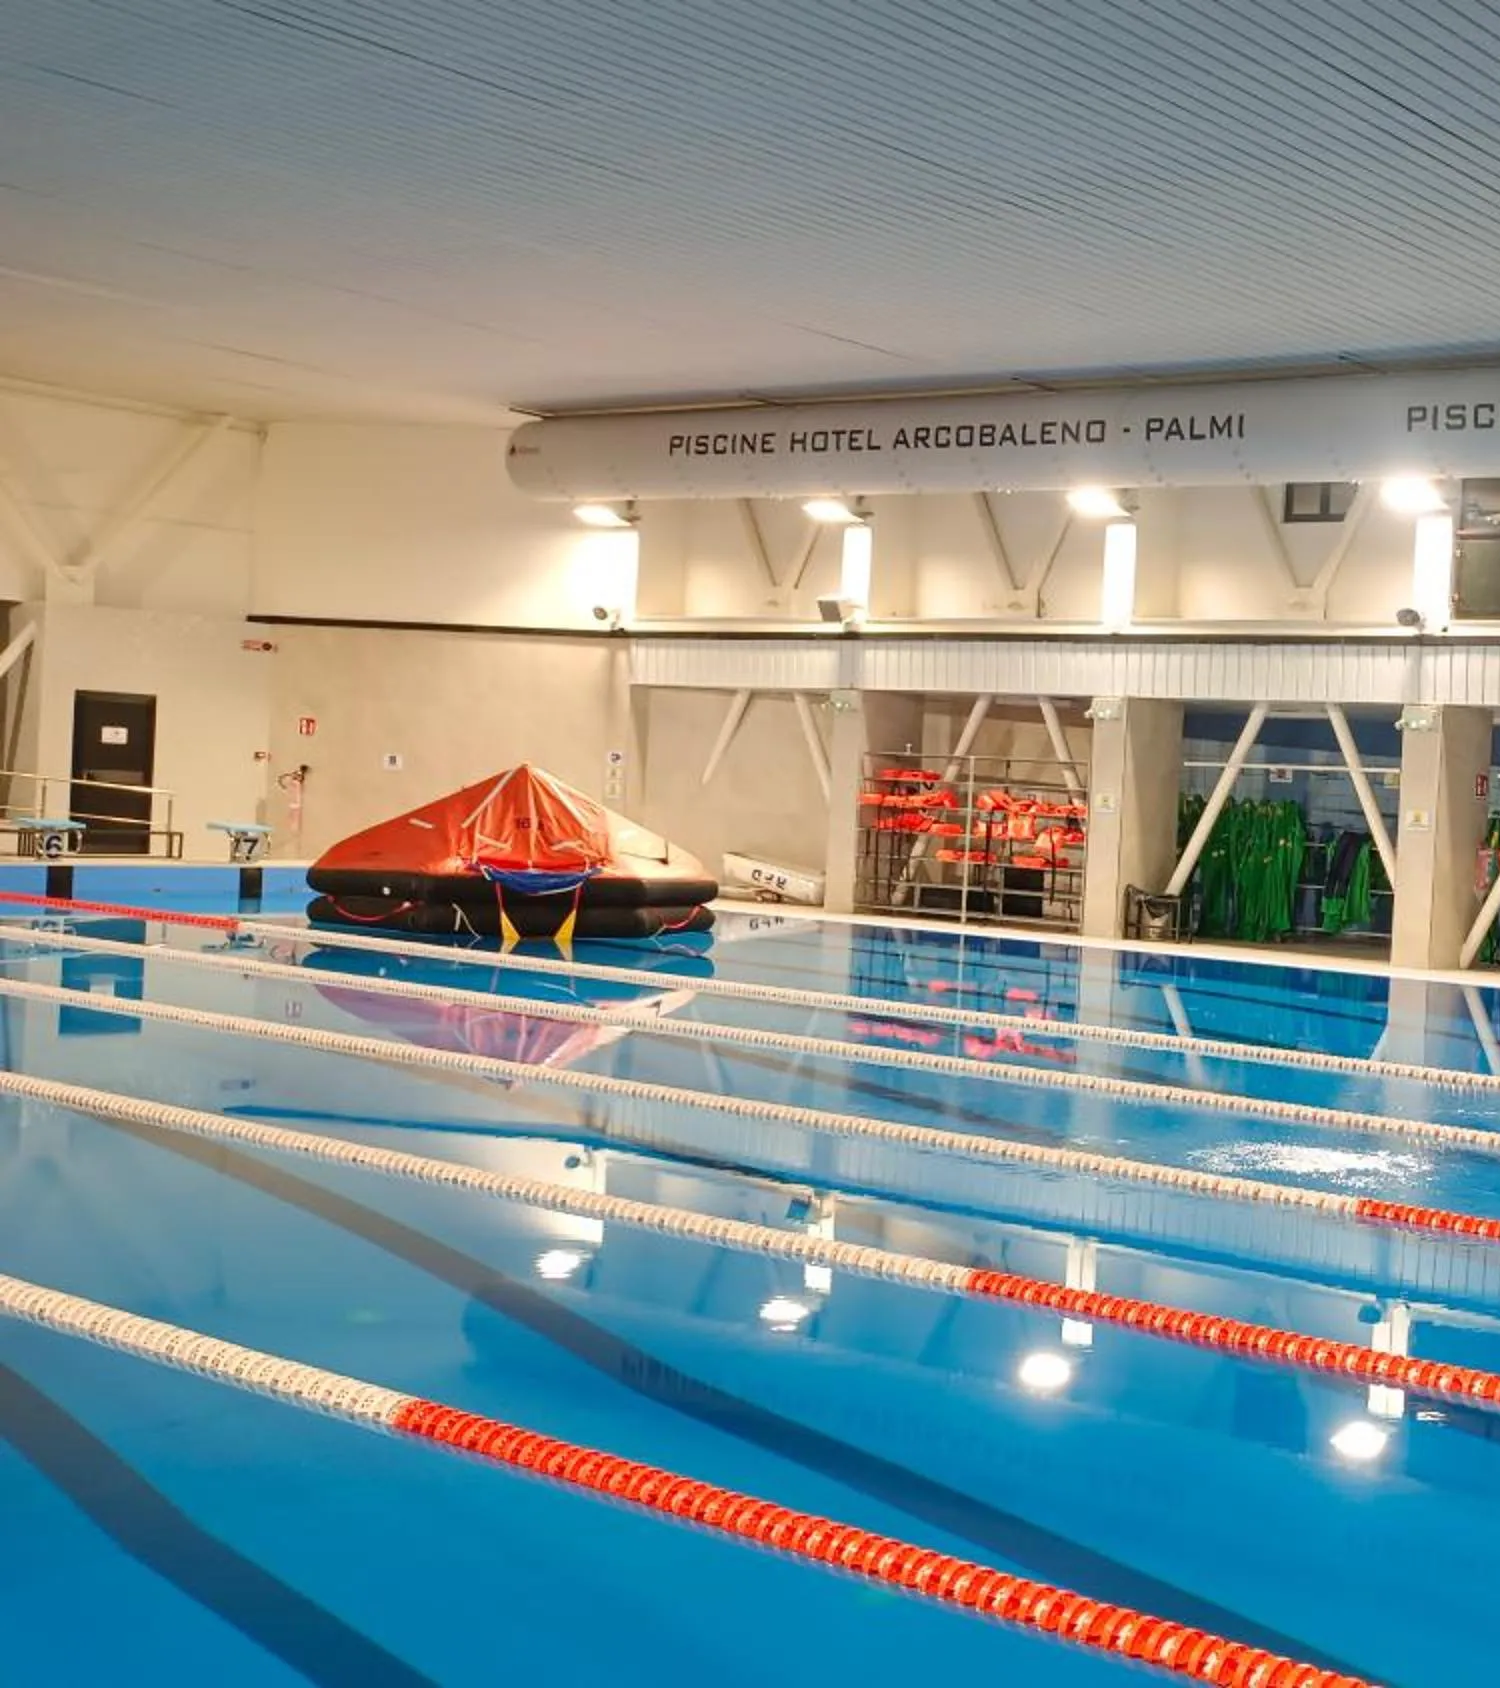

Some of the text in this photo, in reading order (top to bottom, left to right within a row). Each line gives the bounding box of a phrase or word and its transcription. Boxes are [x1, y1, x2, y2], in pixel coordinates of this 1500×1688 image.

[669, 432, 776, 456] PISCINE
[790, 428, 881, 453] HOTEL
[893, 419, 1107, 450] ARCOBALENO
[1145, 413, 1245, 441] PALMI
[45, 835, 62, 859] 6
[243, 837, 259, 861] 7
